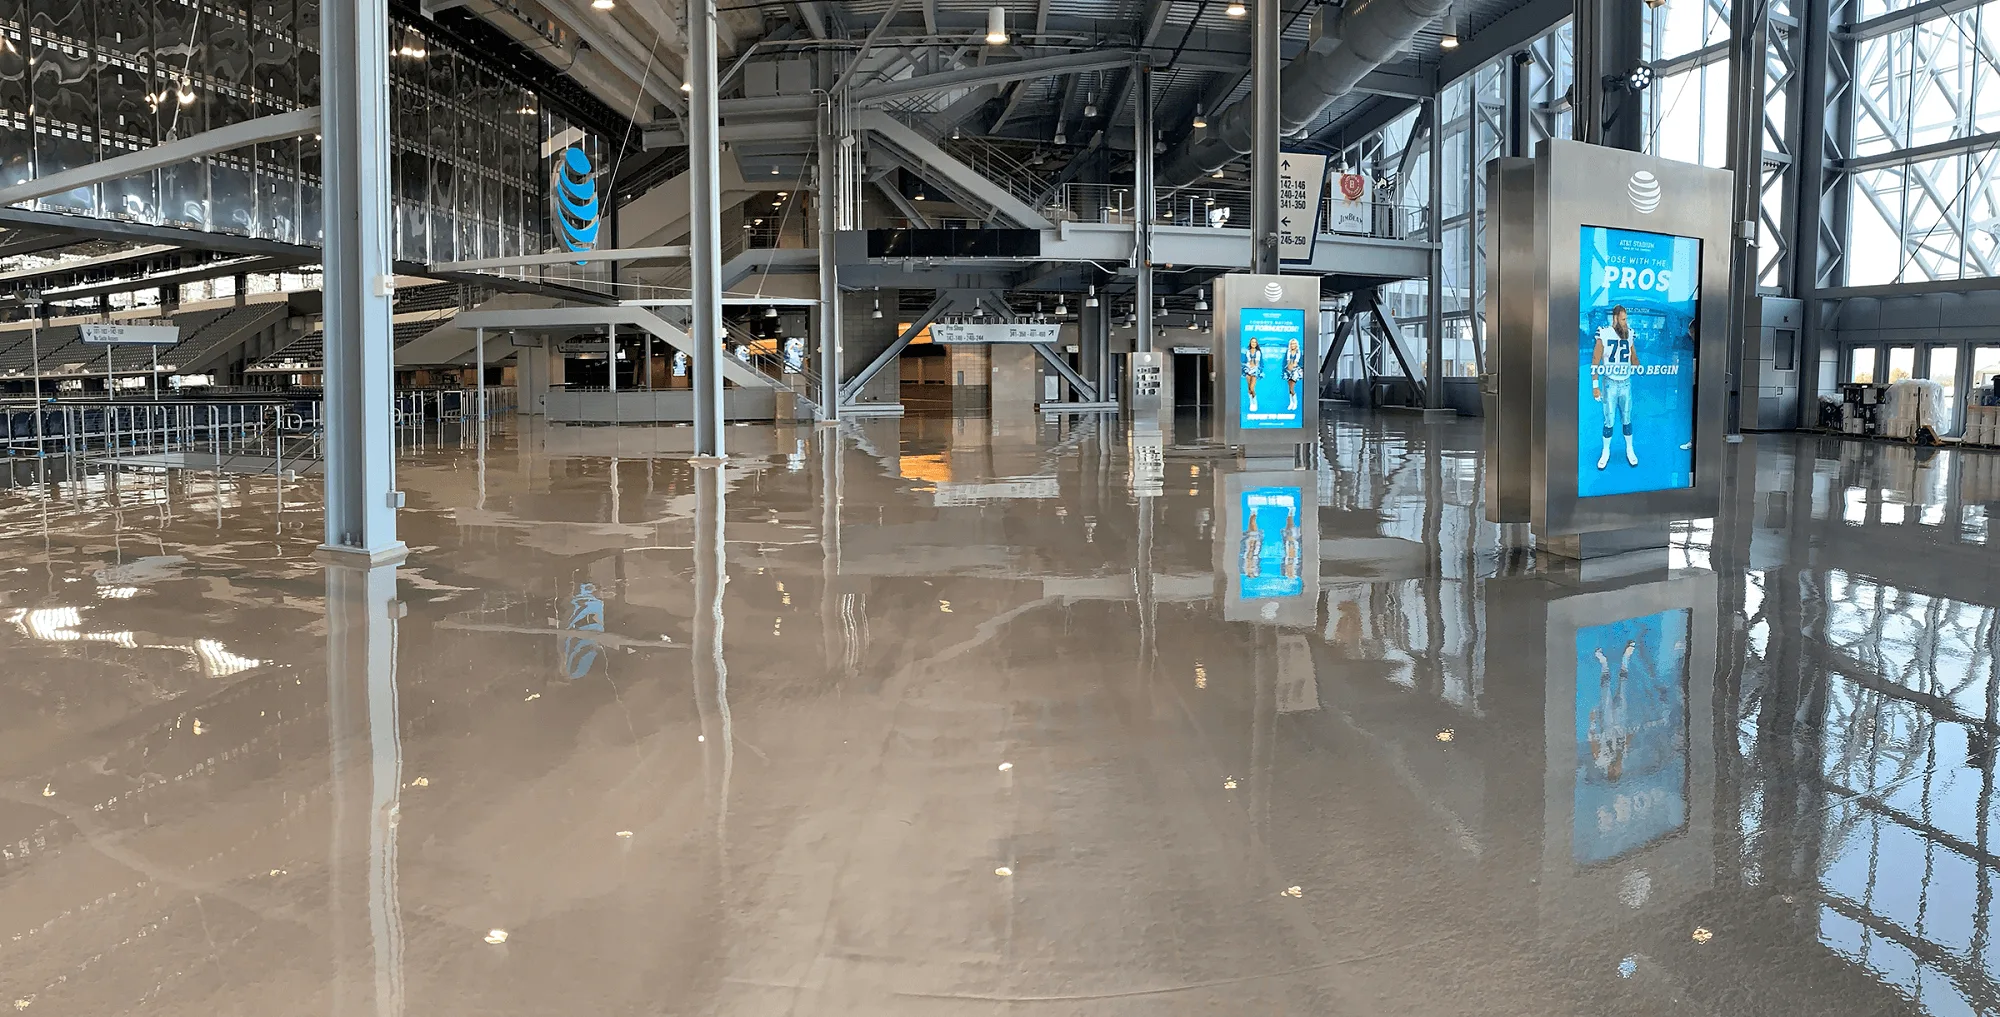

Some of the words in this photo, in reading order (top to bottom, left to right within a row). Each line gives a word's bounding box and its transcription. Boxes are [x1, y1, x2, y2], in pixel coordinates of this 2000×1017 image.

[1280, 180, 1305, 189] 142-146
[1280, 190, 1305, 199] 240-244
[1280, 200, 1306, 210] 341-350
[1280, 235, 1306, 245] 245-250
[1633, 240, 1655, 248] STADIUM
[1606, 255, 1626, 263] POSE
[1629, 256, 1649, 265] WITH
[1652, 258, 1666, 267] THE
[1602, 265, 1672, 292] PROS
[1607, 339, 1630, 363] 72
[1590, 364, 1628, 375] TOUCH
[1629, 365, 1645, 375] TO
[1646, 365, 1679, 375] BEGIN
